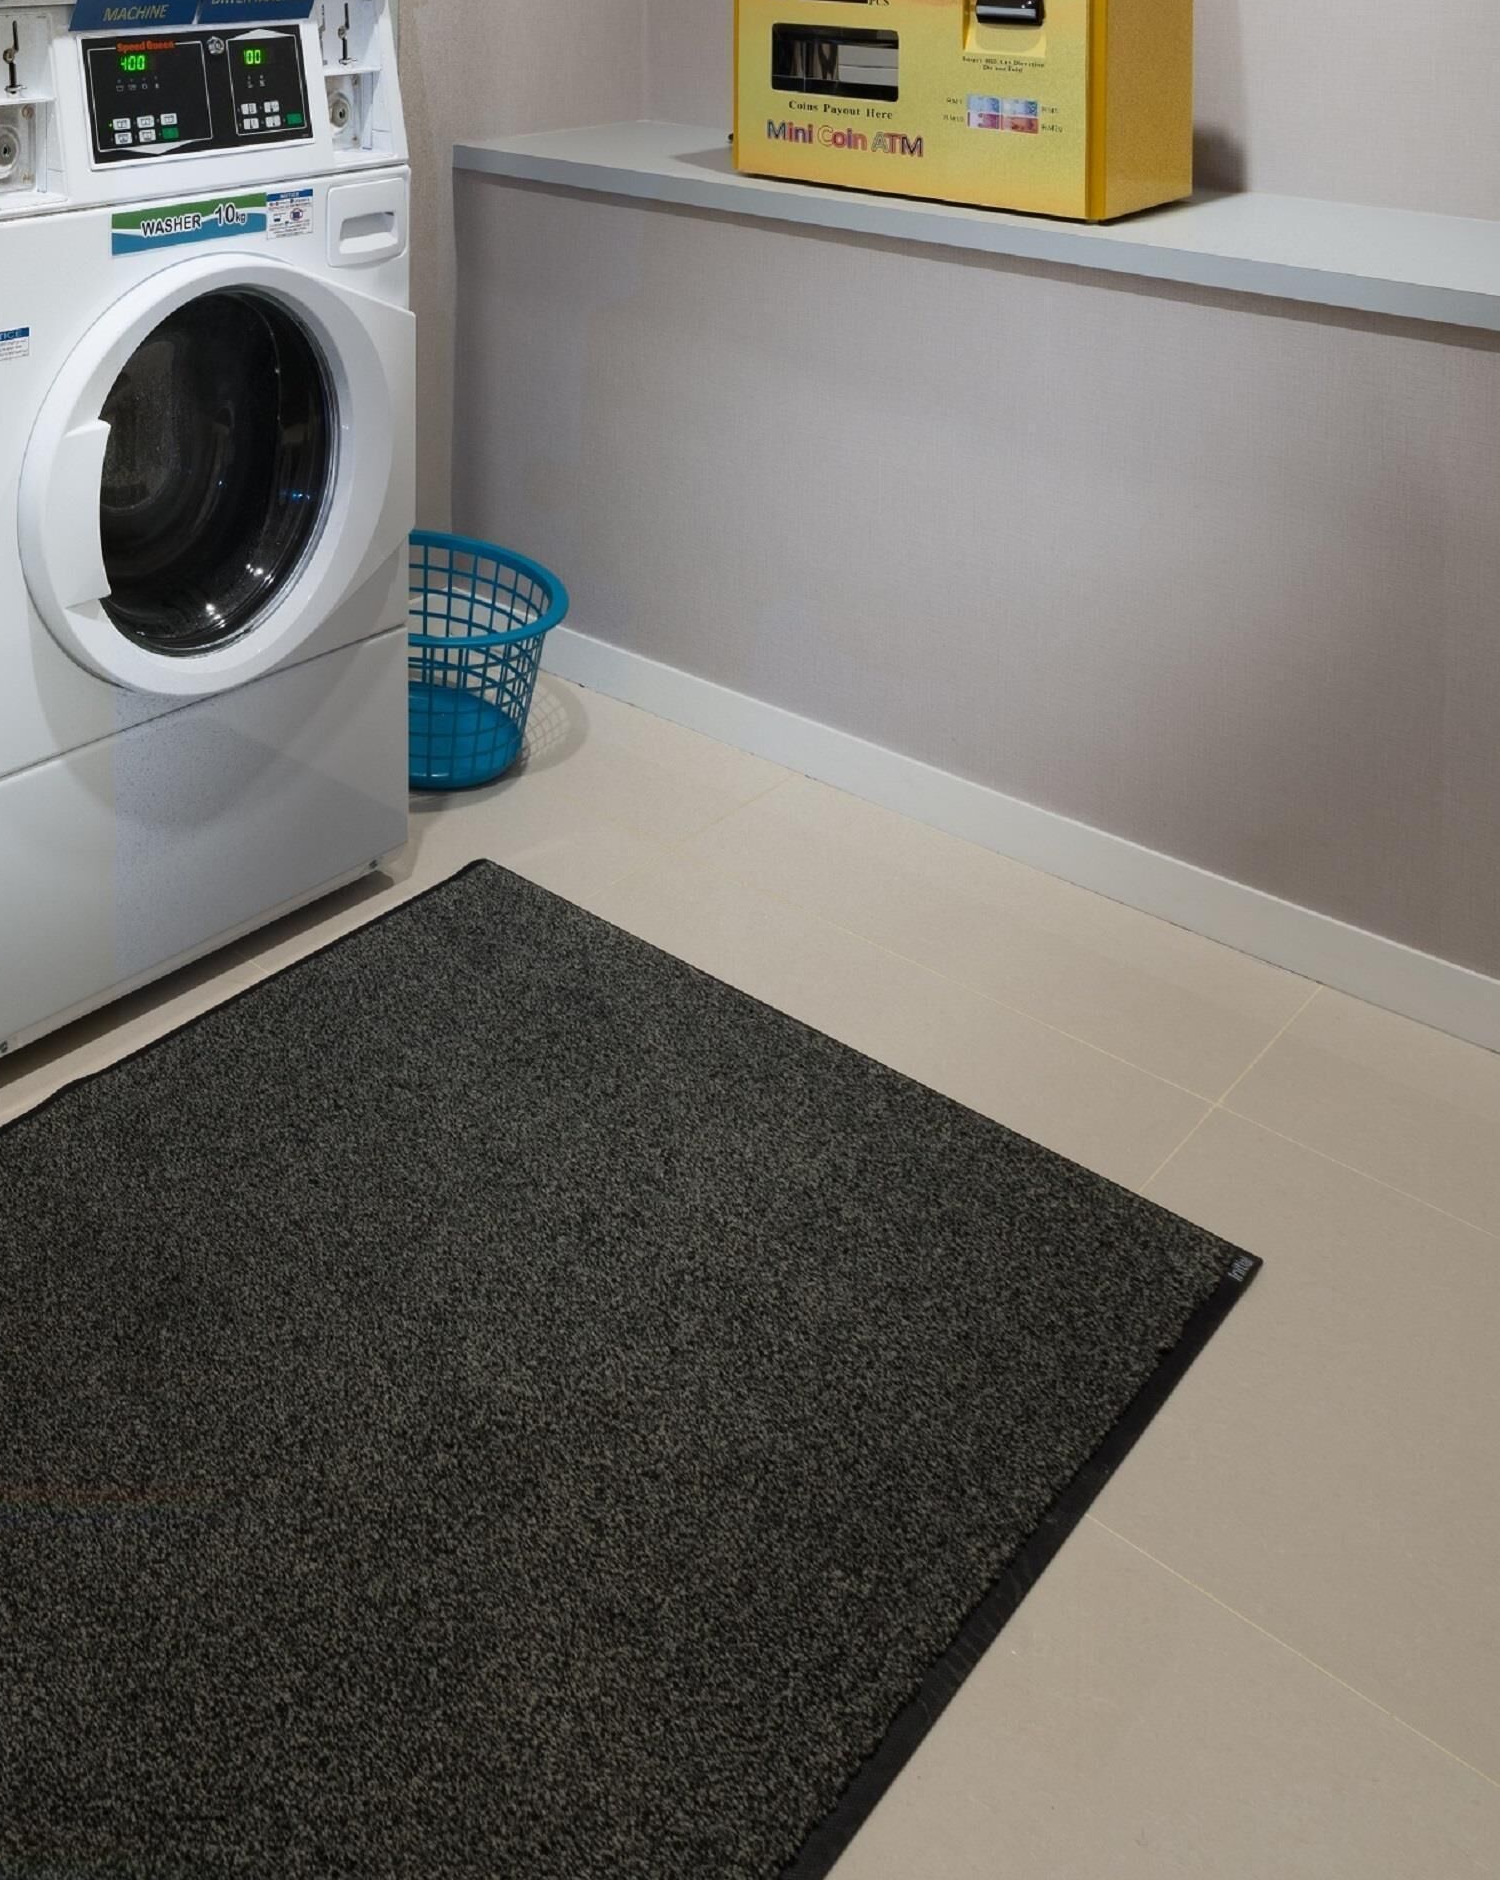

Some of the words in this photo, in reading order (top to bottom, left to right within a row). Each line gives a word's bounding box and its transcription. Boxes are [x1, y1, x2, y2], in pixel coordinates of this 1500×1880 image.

[102, 4, 169, 22] MACHINE
[116, 42, 145, 54] Speed
[788, 100, 818, 111] Coins
[823, 104, 860, 116] Payout
[866, 108, 893, 119] Here
[767, 119, 814, 144] Mini
[817, 124, 867, 151] Coin
[871, 131, 923, 157] ATM
[141, 214, 201, 237] WASHER
